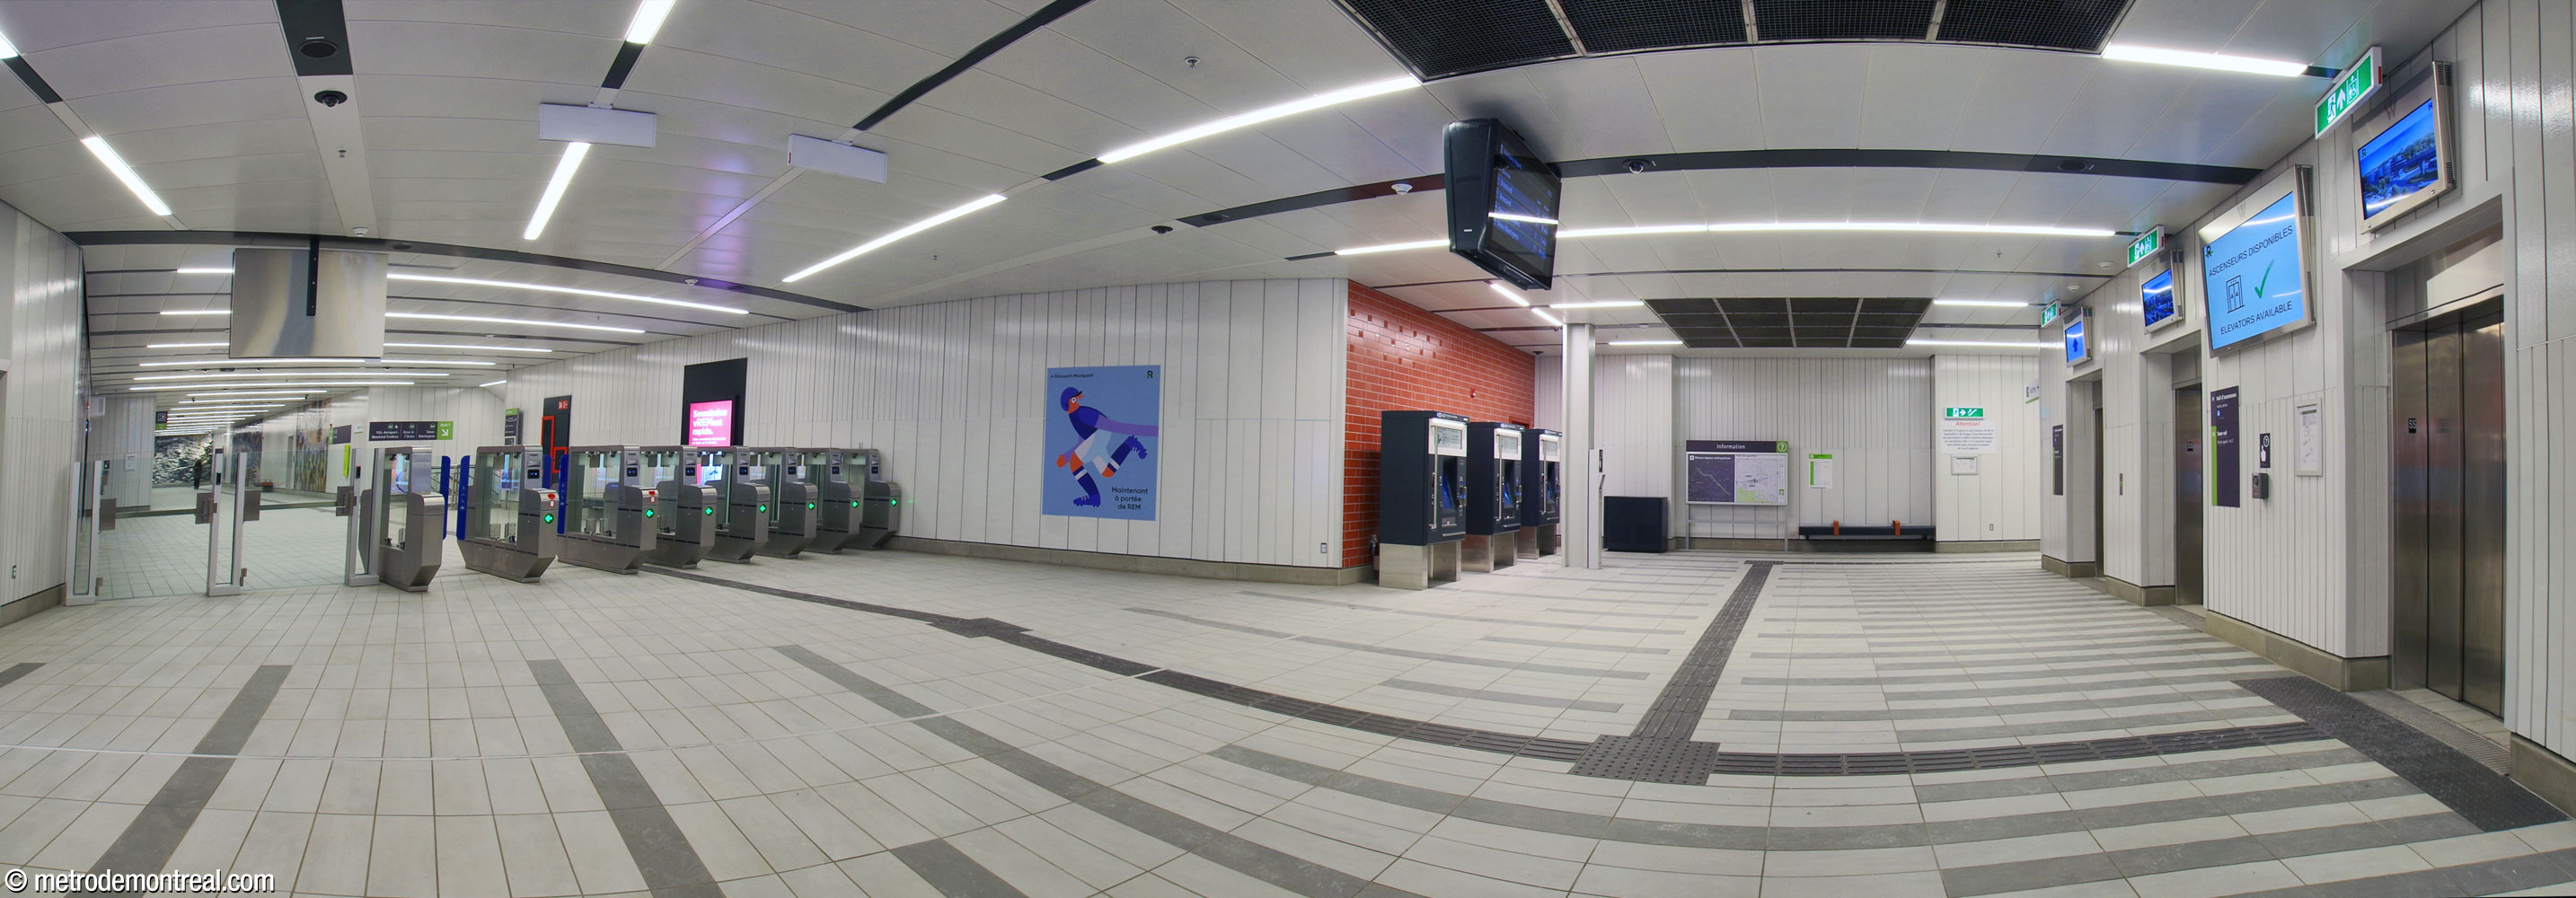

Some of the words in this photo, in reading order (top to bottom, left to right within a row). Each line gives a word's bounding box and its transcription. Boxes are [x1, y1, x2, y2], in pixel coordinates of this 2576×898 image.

[2209, 250, 2248, 277] ASCENSEURS
[2248, 224, 2293, 257] DISPONIBLES
[2220, 314, 2255, 335] ELEVATORS
[2255, 301, 2293, 321] AVAILABLE
